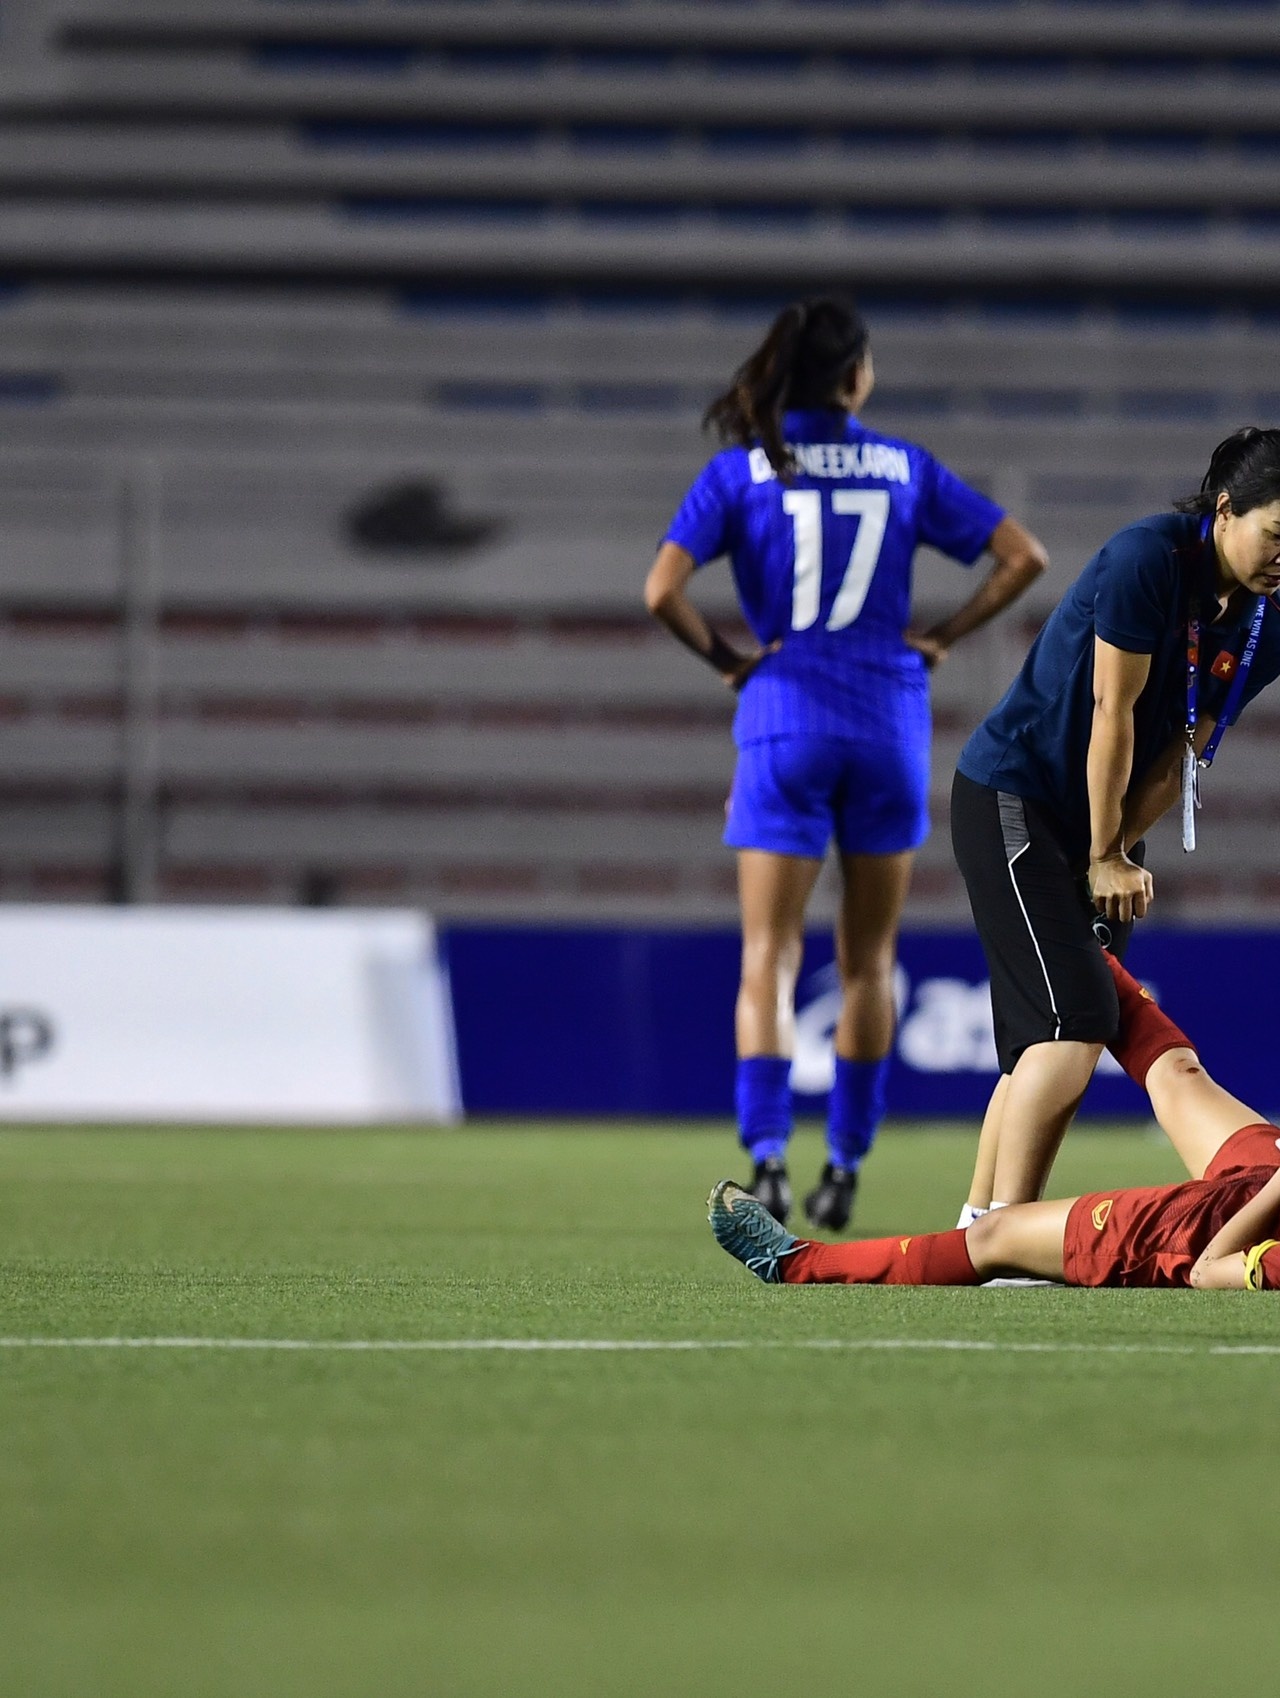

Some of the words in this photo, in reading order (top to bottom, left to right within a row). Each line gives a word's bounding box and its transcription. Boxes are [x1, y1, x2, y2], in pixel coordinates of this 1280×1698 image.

[783, 489, 890, 632] 17
[1255, 603, 1266, 618] WE
[1250, 619, 1262, 637] WIN
[1246, 637, 1258, 650] AS
[1240, 650, 1254, 668] ONE
